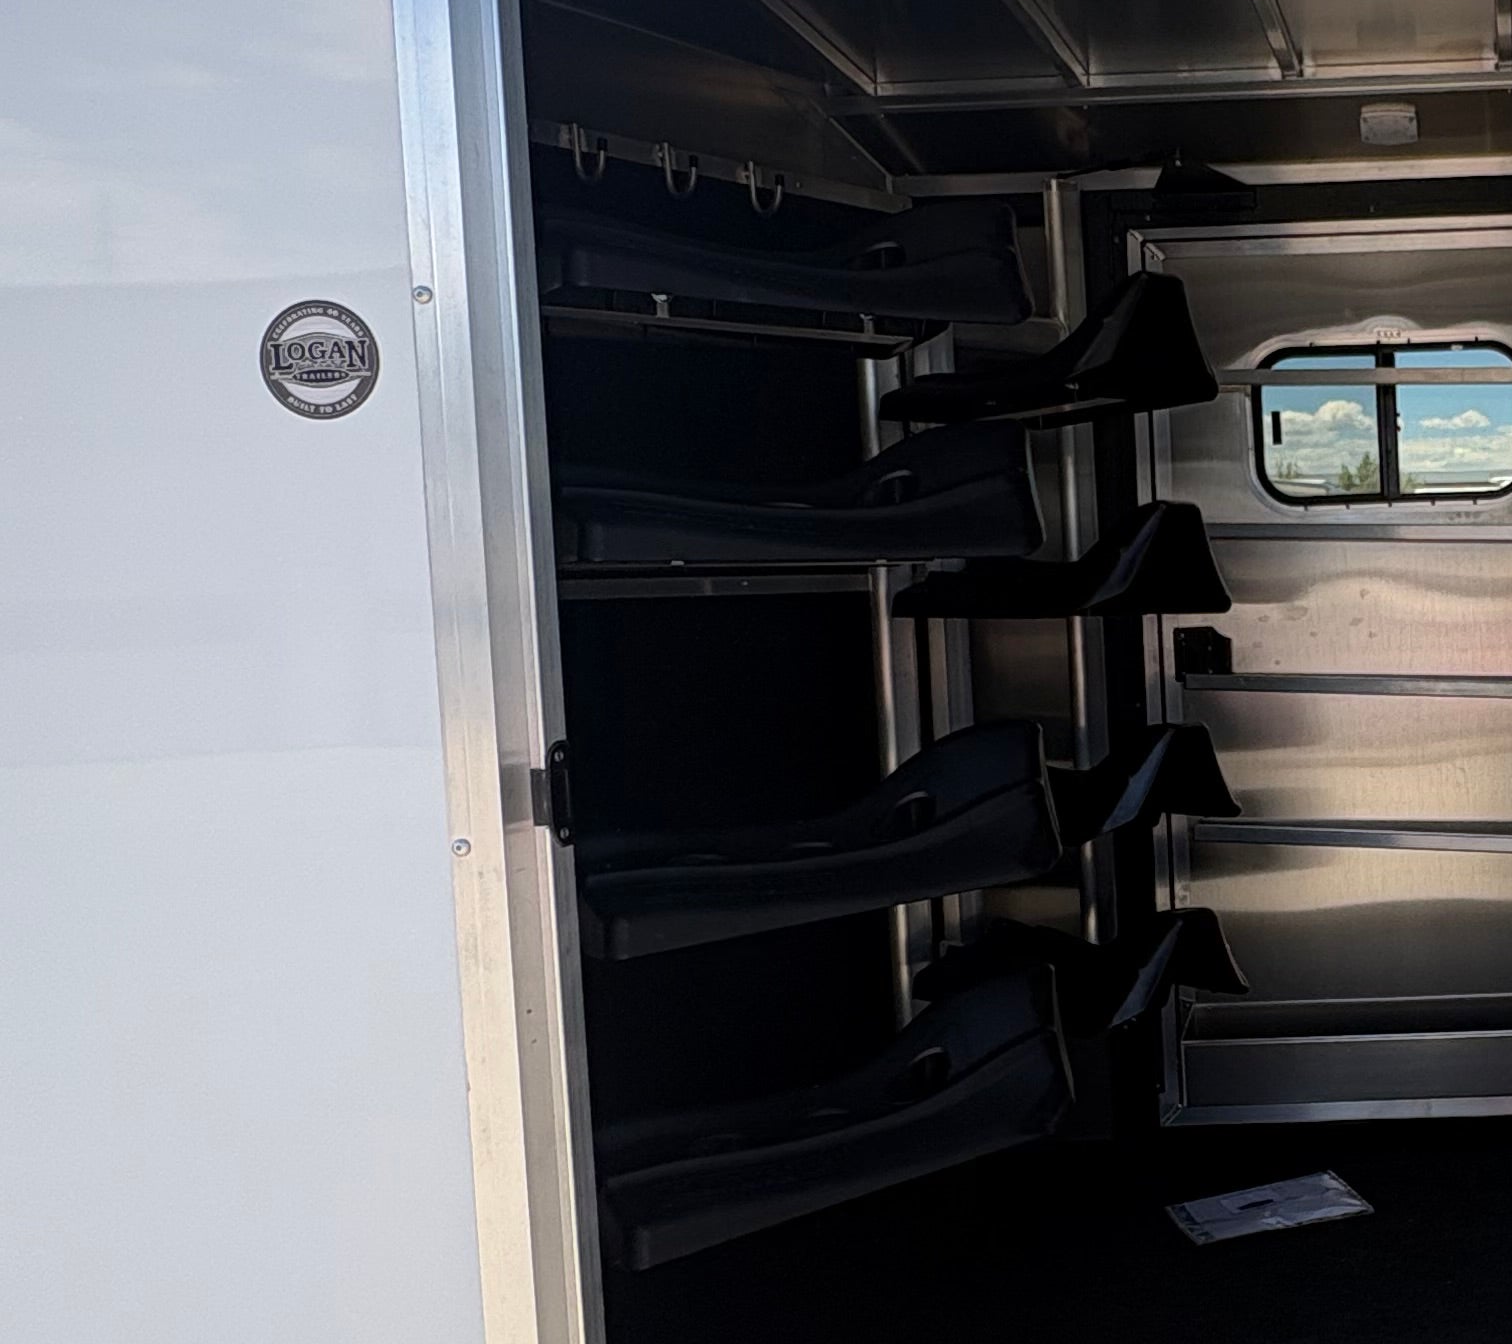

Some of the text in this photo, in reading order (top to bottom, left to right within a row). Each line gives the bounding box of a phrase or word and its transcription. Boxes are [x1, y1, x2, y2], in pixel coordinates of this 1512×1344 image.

[270, 340, 367, 371] LOGAN
[287, 393, 358, 414] BUILT TO LAST
